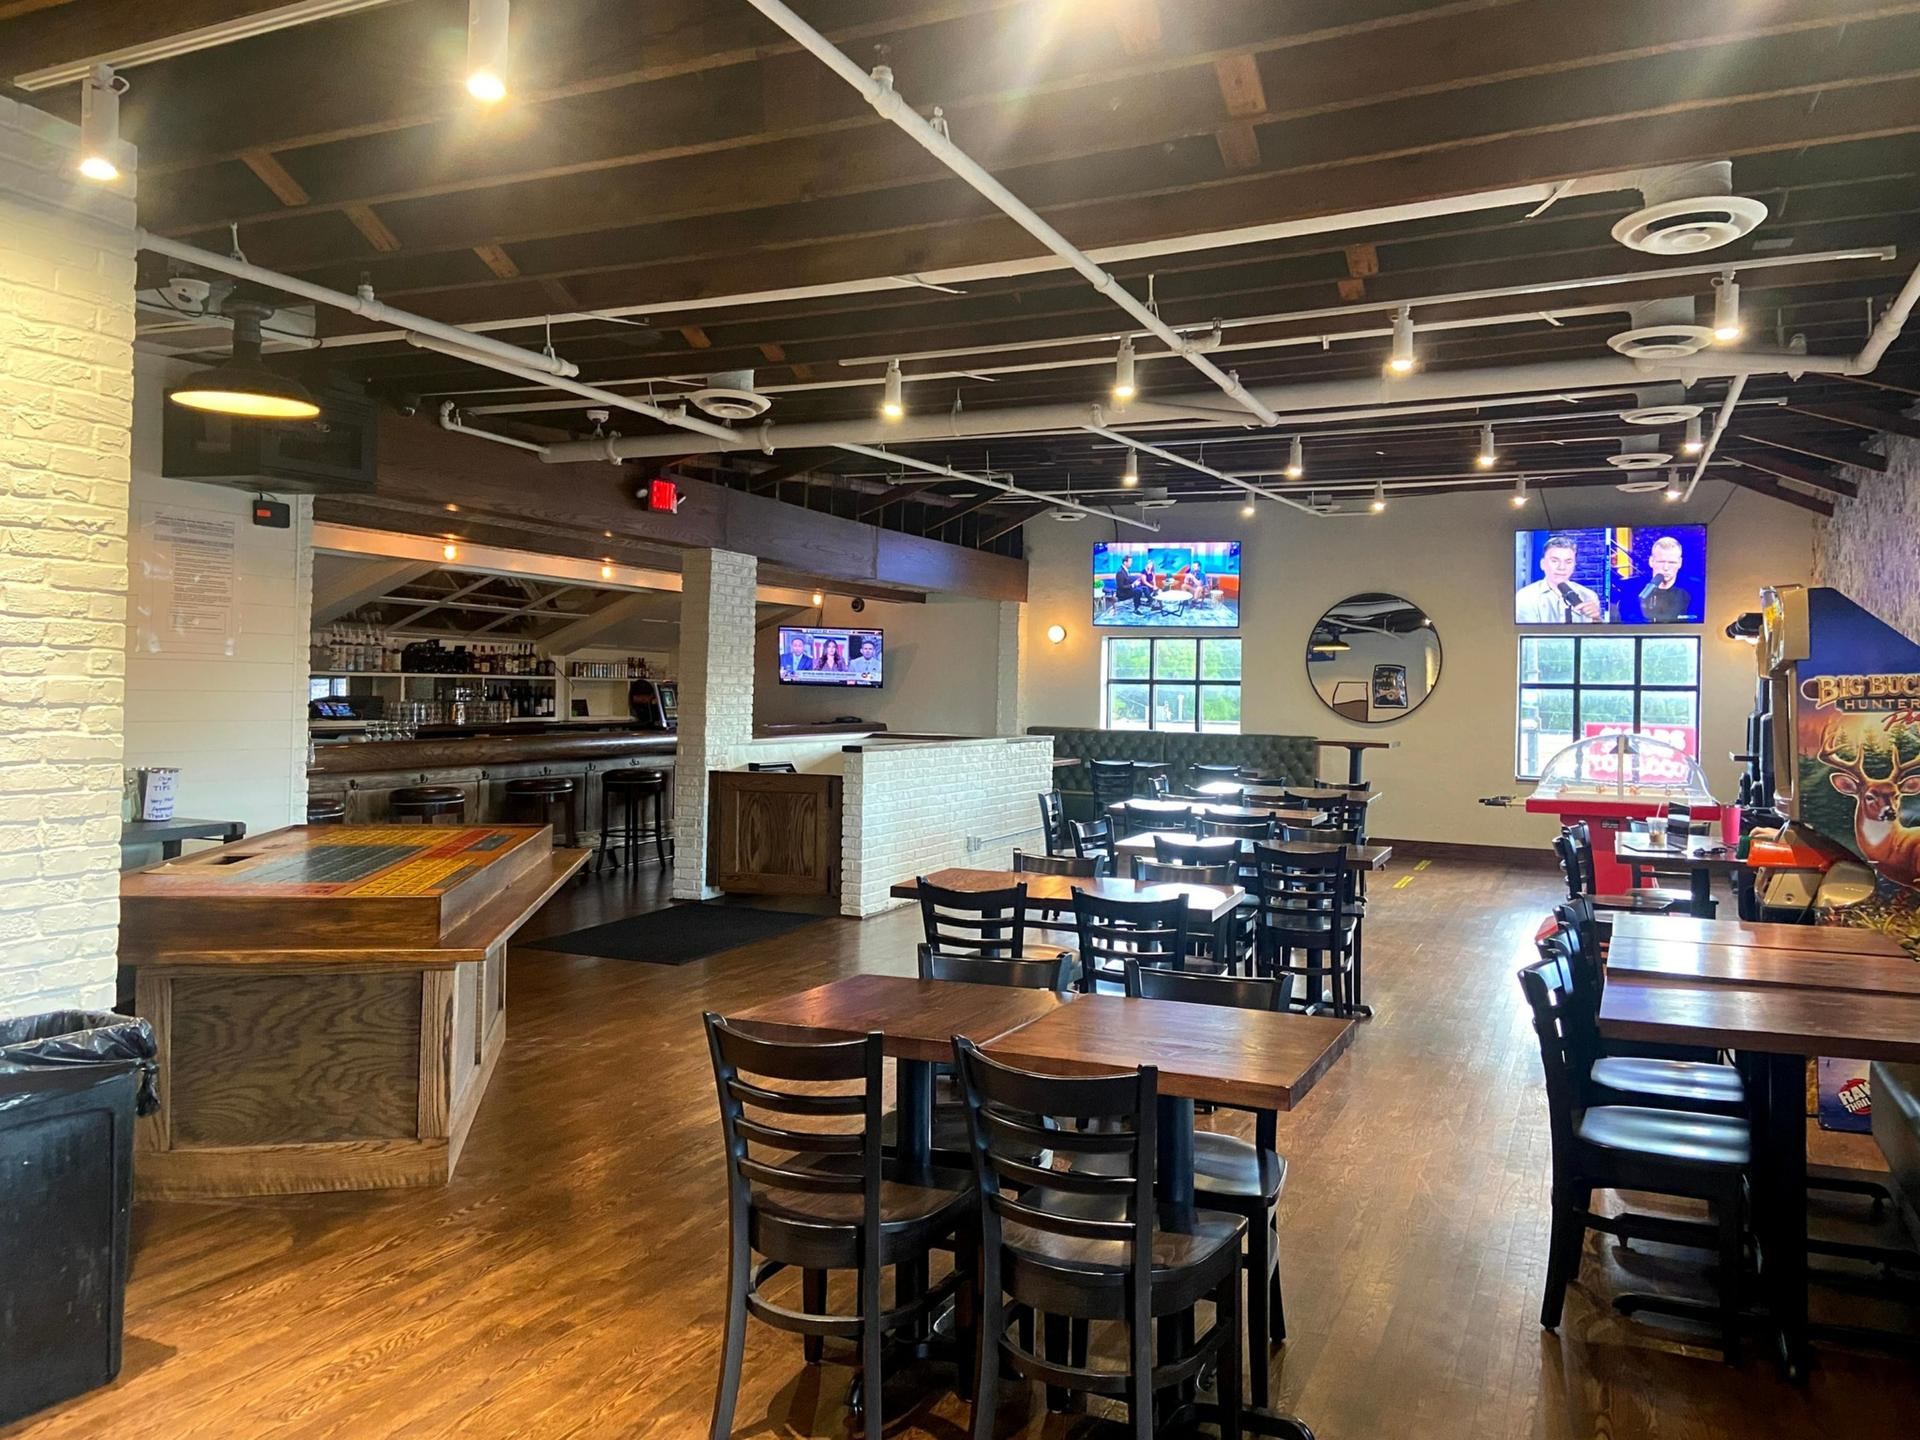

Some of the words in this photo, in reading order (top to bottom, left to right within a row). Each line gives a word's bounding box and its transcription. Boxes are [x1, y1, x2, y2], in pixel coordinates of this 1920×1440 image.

[1816, 676, 1865, 707] BIG
[1868, 676, 1920, 697] BUC
[1844, 698, 1920, 710] HUNTER
